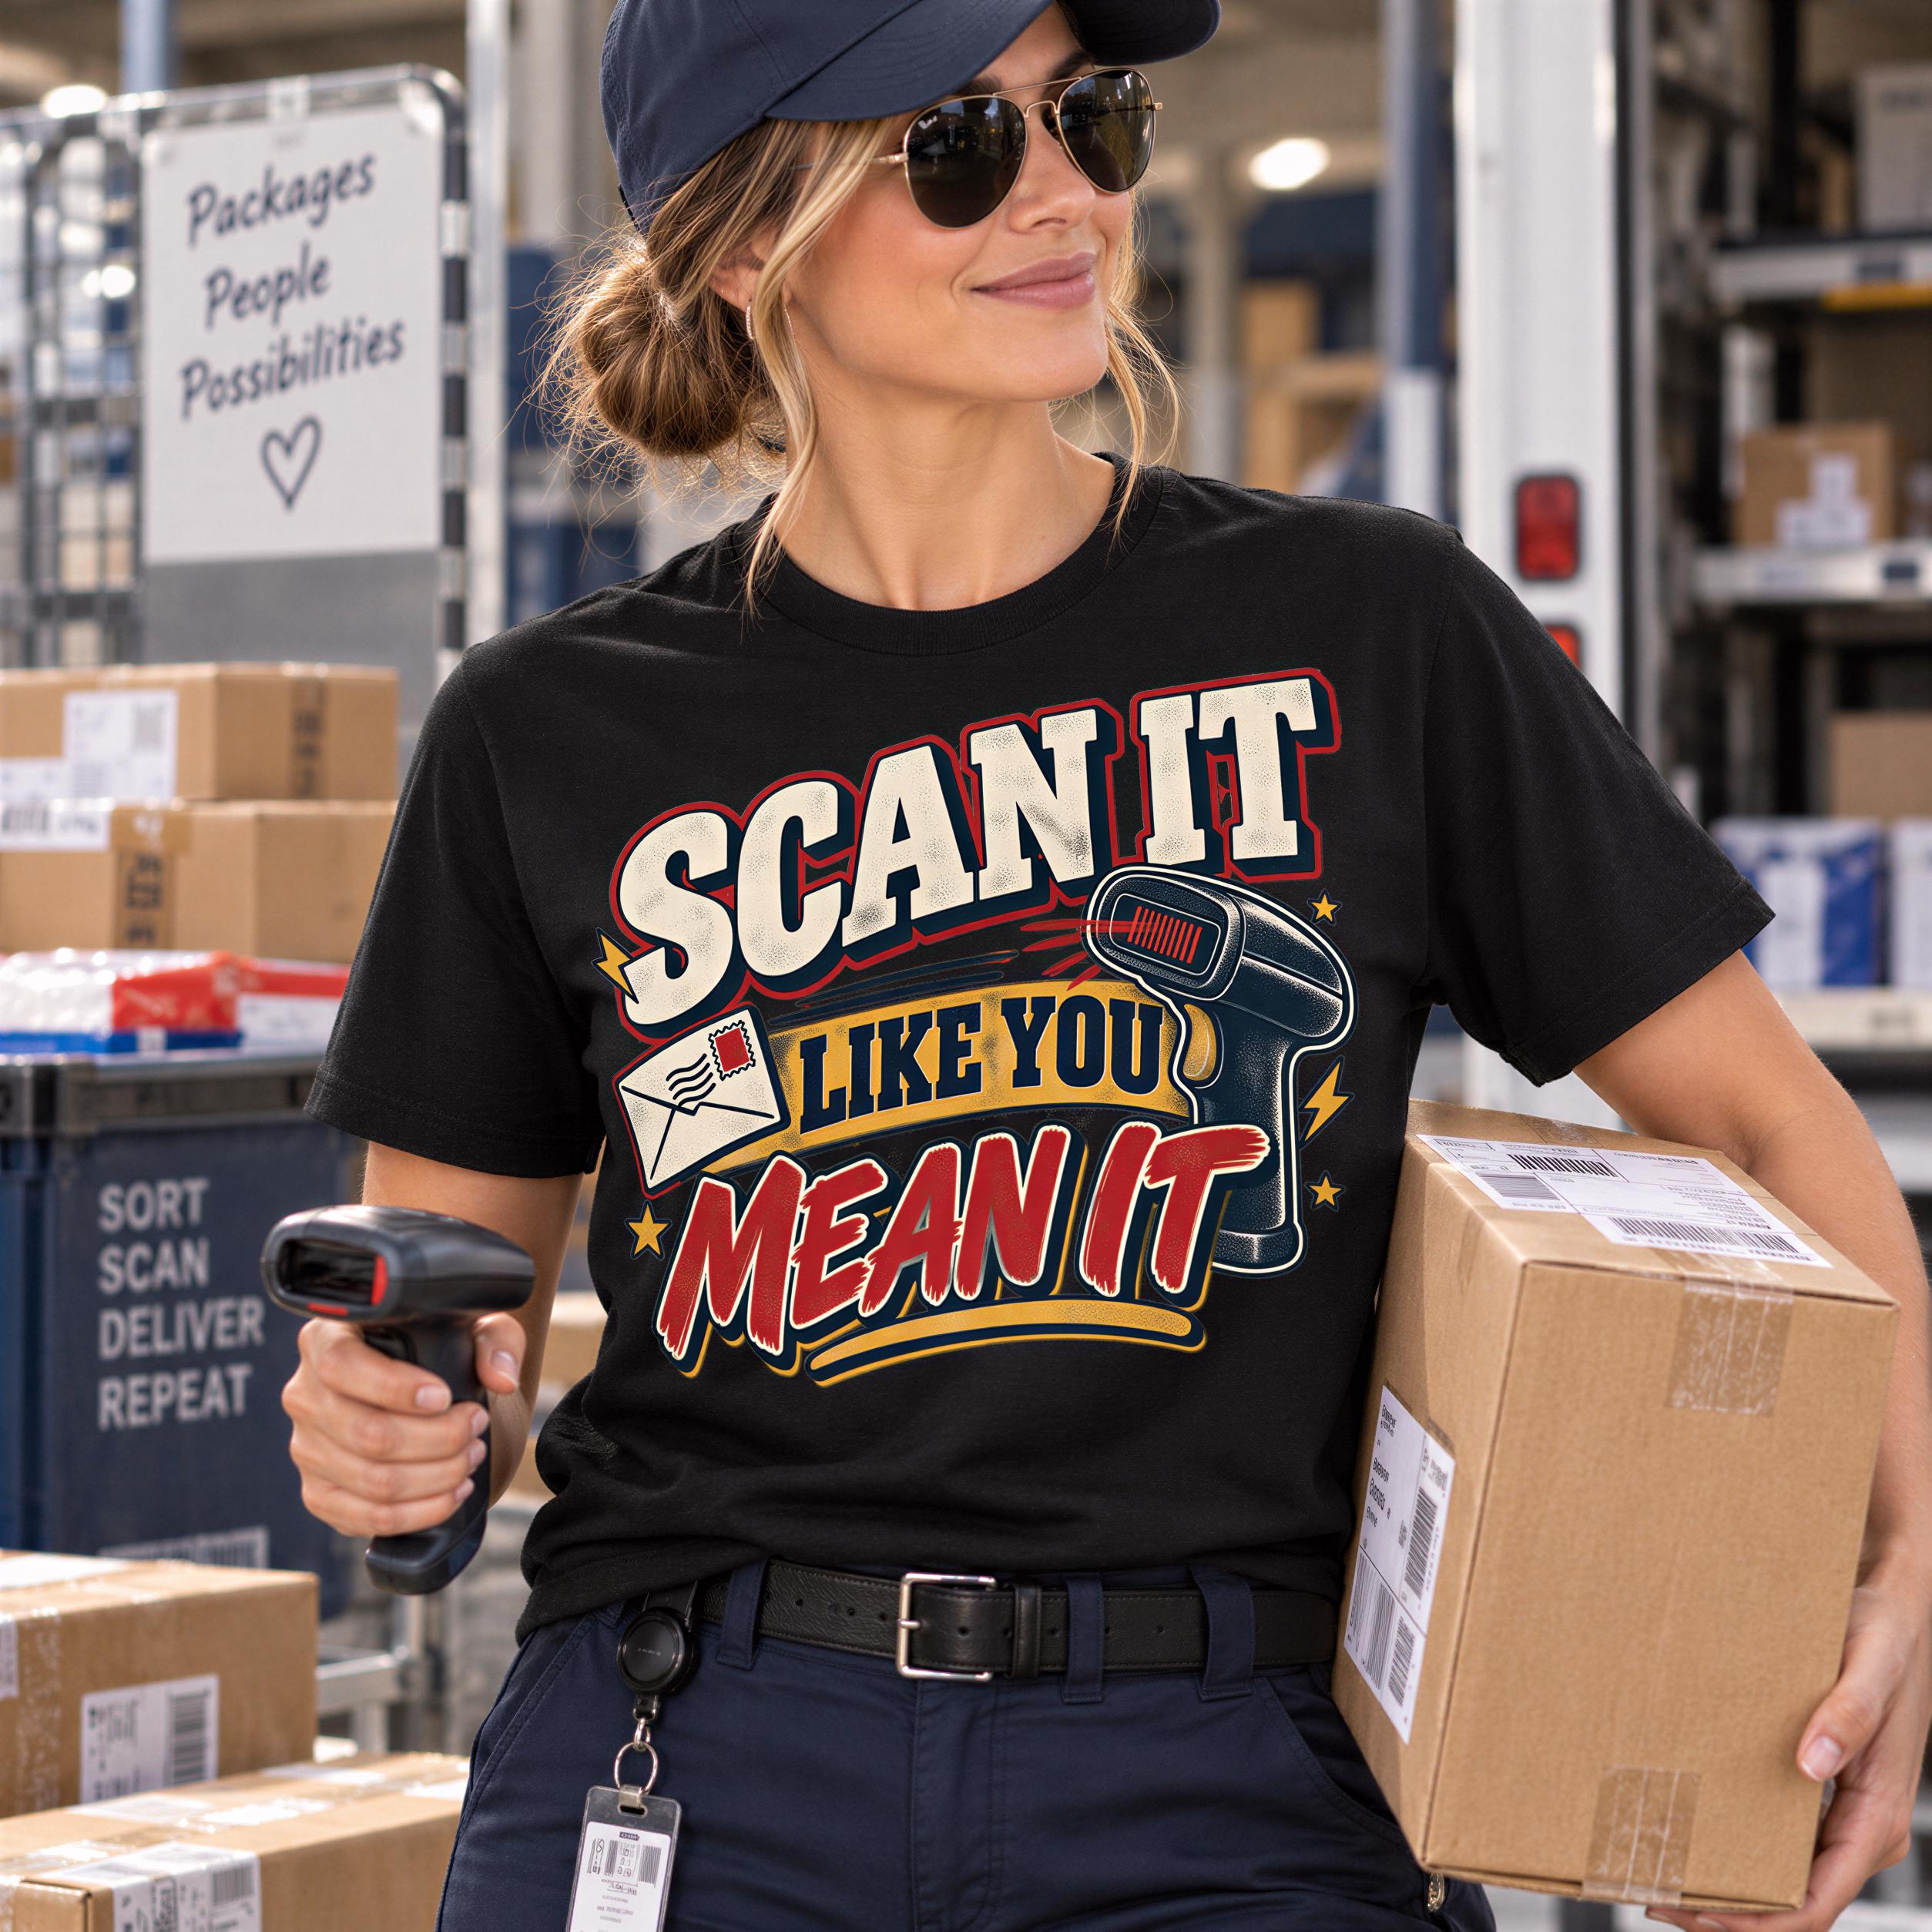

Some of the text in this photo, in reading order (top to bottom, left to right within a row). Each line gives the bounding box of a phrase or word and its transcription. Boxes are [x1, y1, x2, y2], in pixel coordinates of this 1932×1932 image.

[186, 153, 375, 249] Packages
[205, 238, 330, 331] People
[180, 314, 404, 419] Possibilities
[617, 676, 1320, 1027] SCAN IT
[799, 994, 1165, 1135] LIKE YOU
[98, 1175, 210, 1233] SORT
[655, 1120, 1272, 1361] MEAN IT
[97, 1236, 210, 1295] SCAN
[98, 1294, 266, 1361] DELIVER
[99, 1362, 254, 1433] REPEAT
